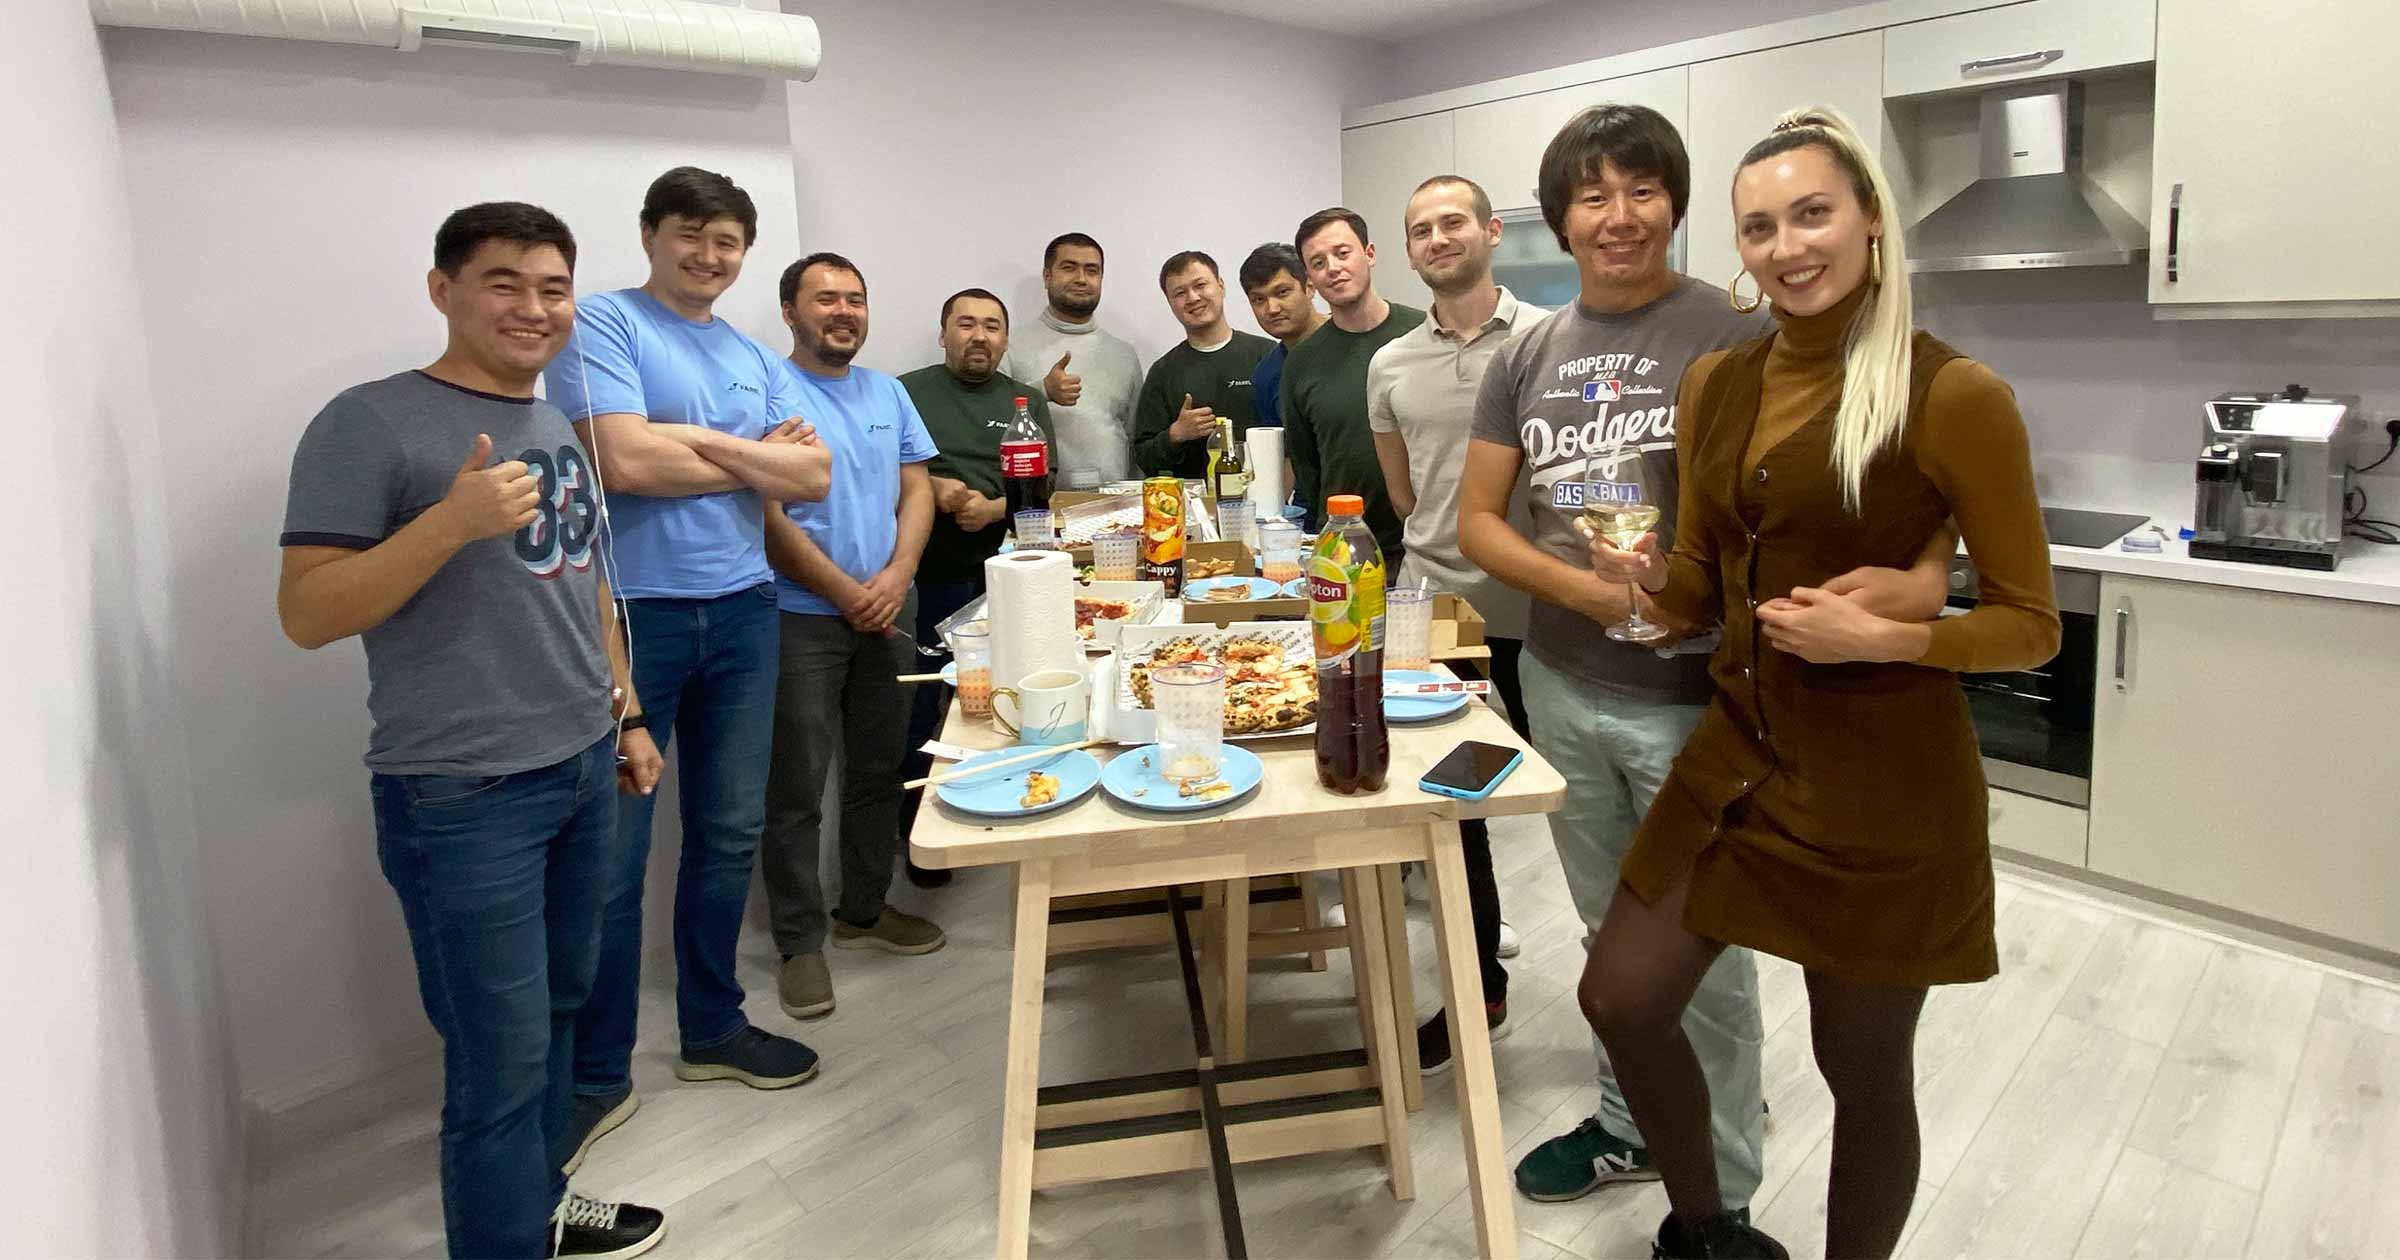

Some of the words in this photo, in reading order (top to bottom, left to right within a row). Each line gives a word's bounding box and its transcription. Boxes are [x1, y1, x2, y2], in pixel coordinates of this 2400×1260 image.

[1558, 353, 1635, 381] PROPERTY
[1634, 357, 1659, 376] OF
[1145, 563, 1177, 577] Cappy
